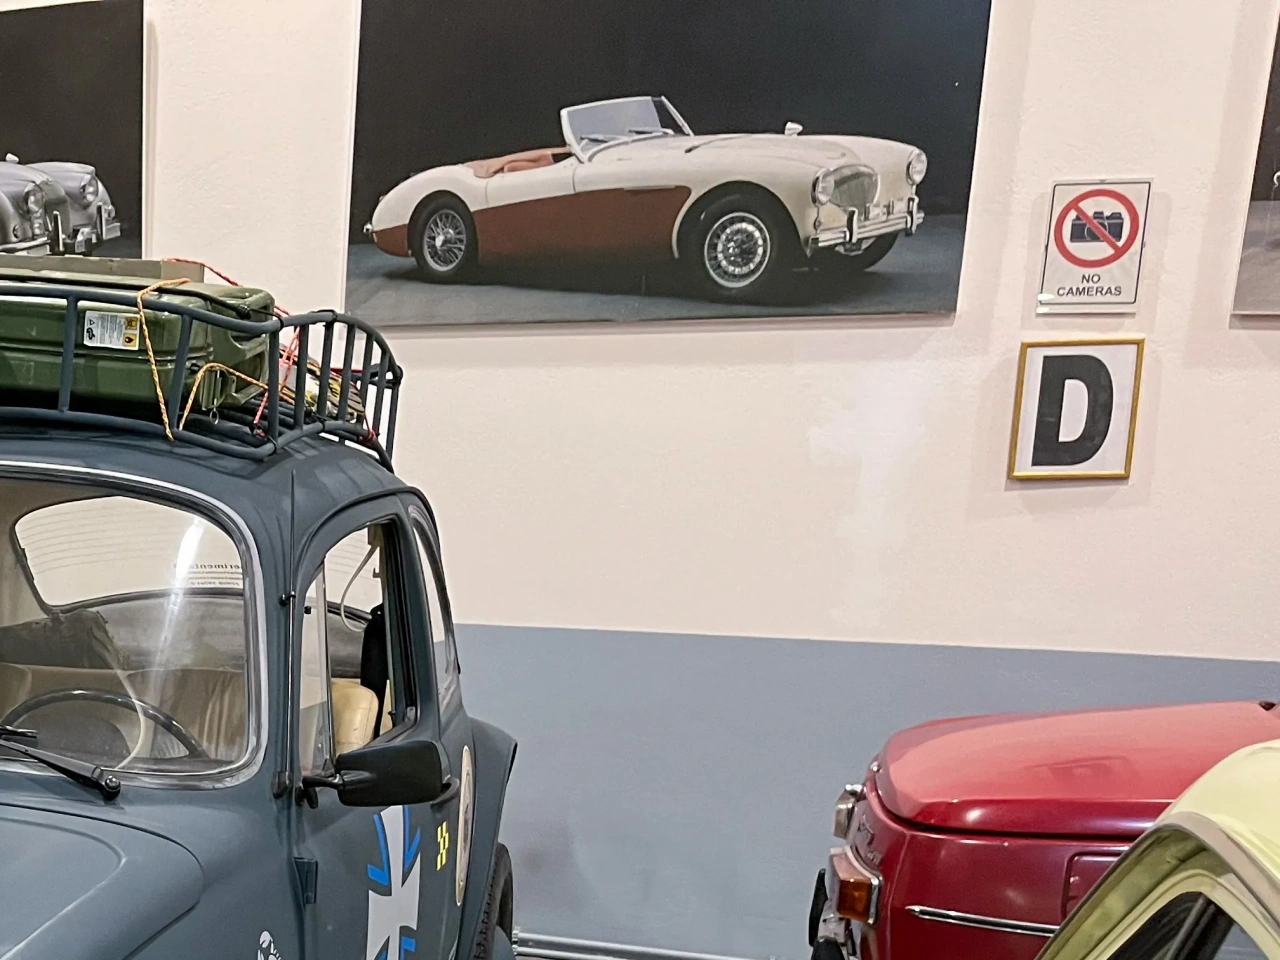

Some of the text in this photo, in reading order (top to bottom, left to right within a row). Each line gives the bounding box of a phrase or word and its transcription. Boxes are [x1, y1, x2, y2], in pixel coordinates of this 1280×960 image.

[1081, 273, 1101, 285] NO
[1057, 285, 1122, 298] CAMERAS
[1031, 354, 1114, 467] D
